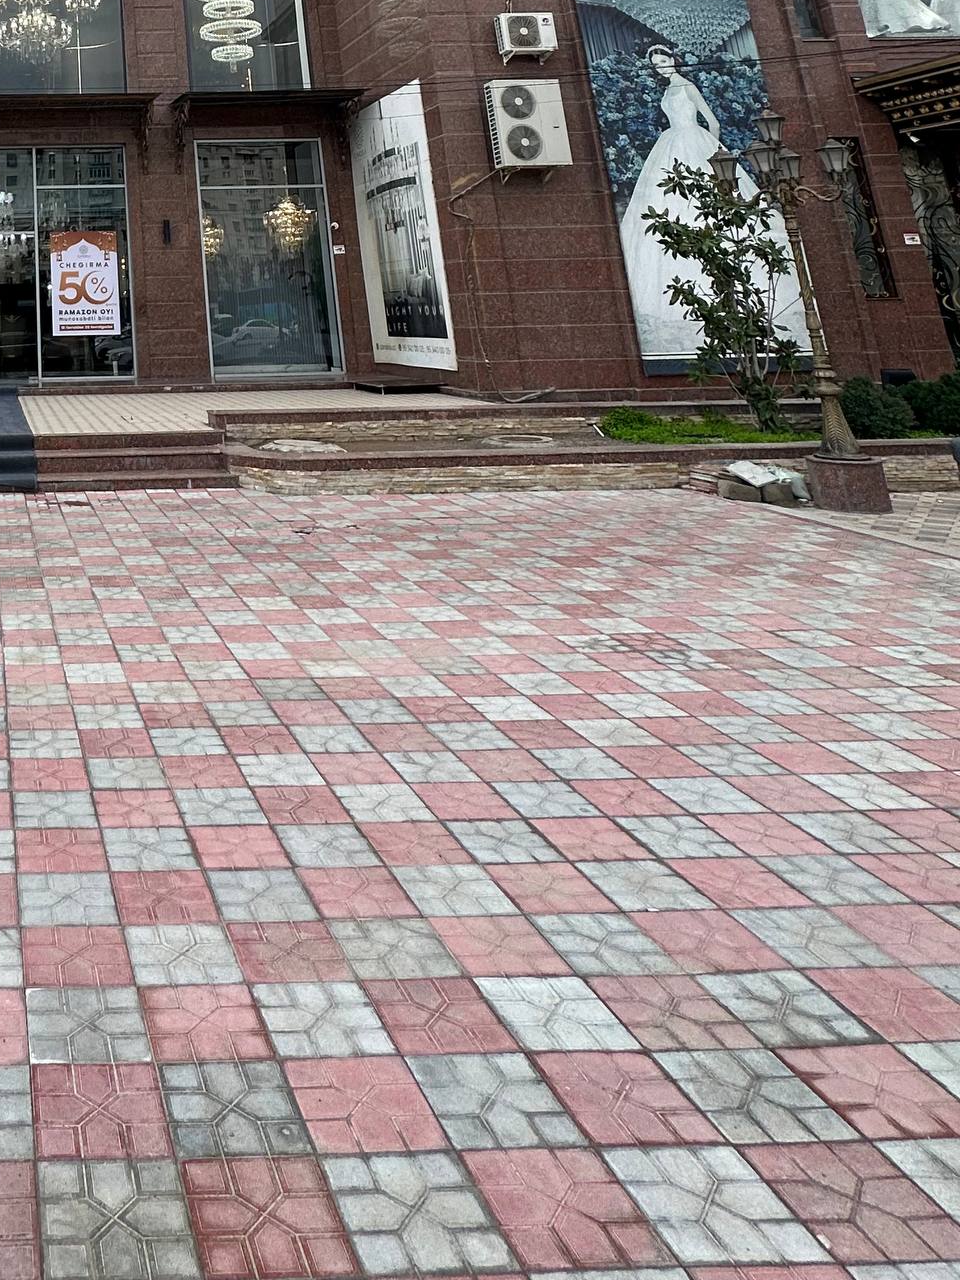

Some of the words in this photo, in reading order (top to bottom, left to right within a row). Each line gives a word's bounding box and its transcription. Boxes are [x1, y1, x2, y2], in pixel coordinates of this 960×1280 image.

[59, 261, 110, 269] CHEGIRMA
[386, 305, 412, 317] LIGHT
[418, 304, 445, 316] YOUR
[388, 322, 408, 333] LIFE
